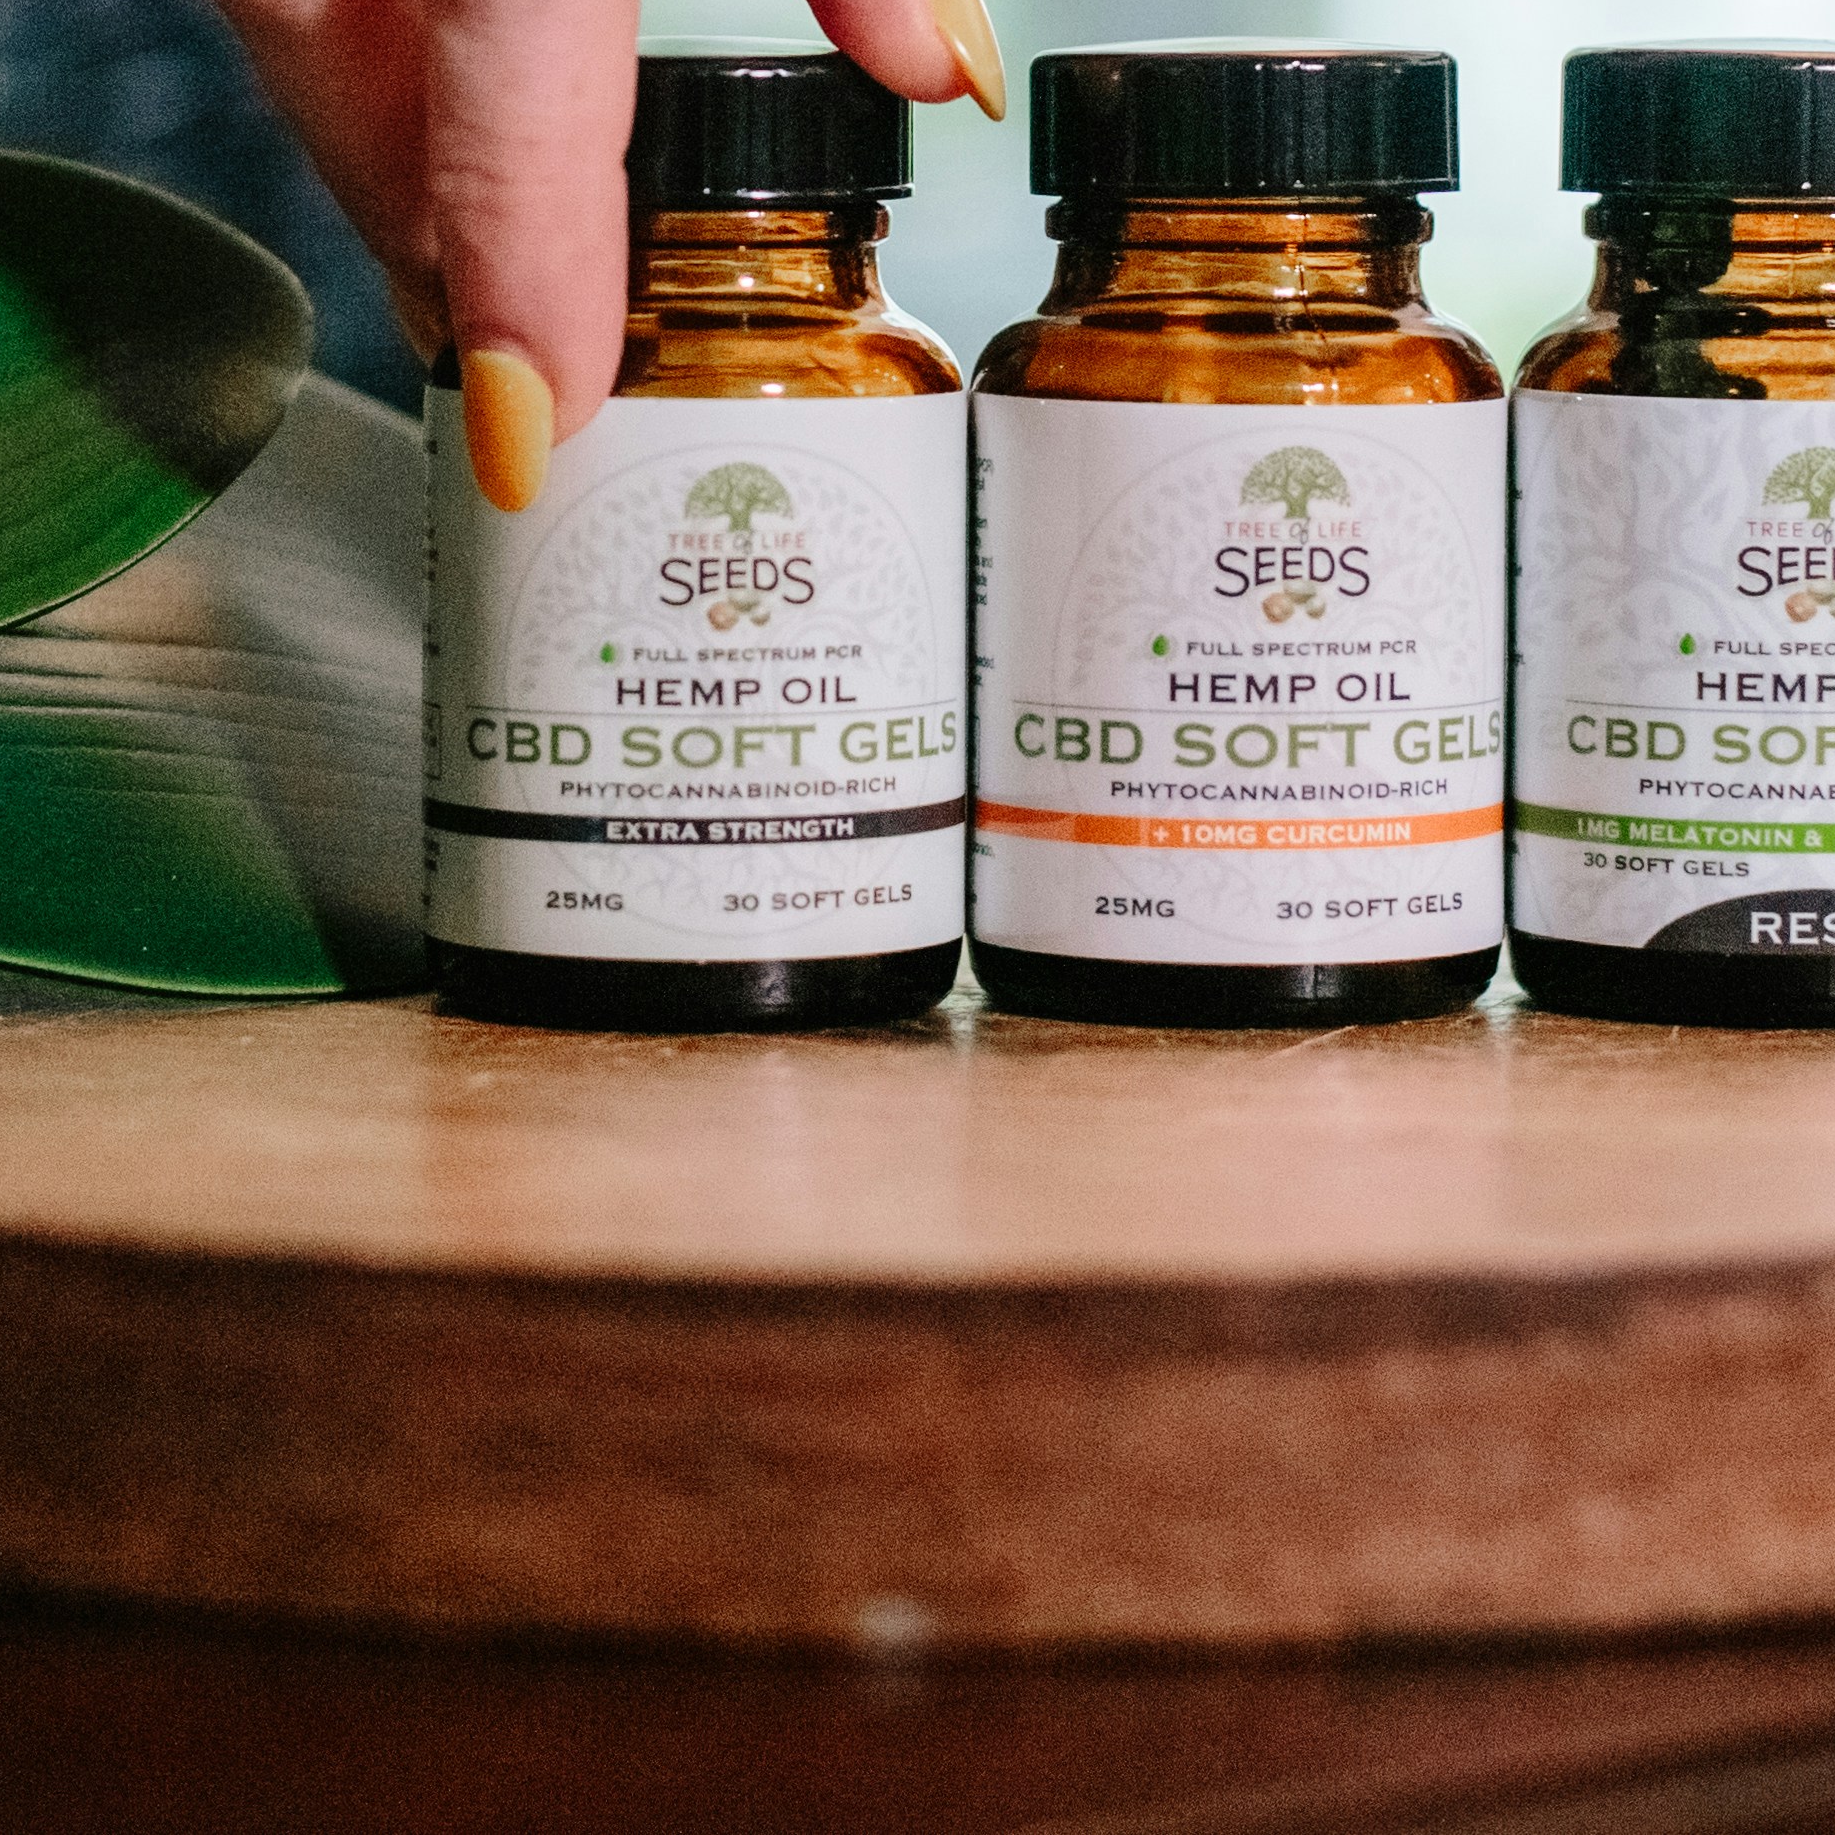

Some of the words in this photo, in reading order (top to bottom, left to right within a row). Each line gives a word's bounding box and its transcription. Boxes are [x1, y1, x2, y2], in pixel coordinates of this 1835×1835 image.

[668, 533, 723, 550] TREE
[761, 532, 807, 549] LIFE
[1224, 522, 1279, 538] TREE
[1318, 521, 1362, 538] LIFE
[1748, 521, 1803, 538] TREE
[659, 558, 815, 606] SEEDS
[1215, 546, 1370, 597] SEEDS
[633, 648, 687, 662] FULL
[697, 646, 816, 662] SPECTRUM
[824, 645, 862, 658] PCR
[1187, 642, 1243, 656] FULL
[1252, 641, 1371, 656] SPECTRUM
[1380, 640, 1417, 655] PCR
[1714, 641, 1771, 656] FULL
[616, 679, 760, 706] HEMP
[782, 677, 857, 703] OIL
[1169, 673, 1316, 703] HEMP
[1336, 673, 1411, 701] OIL
[466, 719, 591, 765] CBD
[621, 725, 816, 767] SOFT
[840, 712, 957, 764] GELS
[1014, 714, 1143, 765] CBD
[1173, 724, 1370, 767] SOFT
[1393, 712, 1501, 765] GELS
[1567, 715, 1686, 762] CBD
[560, 776, 897, 799] PHYTOCANNABINOID-RICH
[1110, 779, 1448, 800] PHYTOCANNABINOID-RICH
[606, 821, 700, 842] EXTRA
[708, 818, 854, 841] STRENGTH
[1153, 827, 1167, 842] +
[1180, 824, 1258, 845] 10MG
[1267, 822, 1411, 844] CURCUMIN
[1577, 819, 1620, 840] 1MG
[1629, 822, 1793, 847] MELATONIN
[1805, 828, 1823, 847] &
[1583, 852, 1607, 868] 30
[1614, 856, 1674, 874] SOFT
[1683, 859, 1749, 877] GELS
[545, 890, 624, 912] 25MG
[723, 894, 758, 912] 30
[771, 890, 844, 910] SOFT
[854, 884, 913, 906] GELS
[1095, 896, 1174, 918] 25MG
[1276, 901, 1312, 919] 30
[1325, 897, 1398, 918] SOFT
[1407, 893, 1463, 914] GELS
